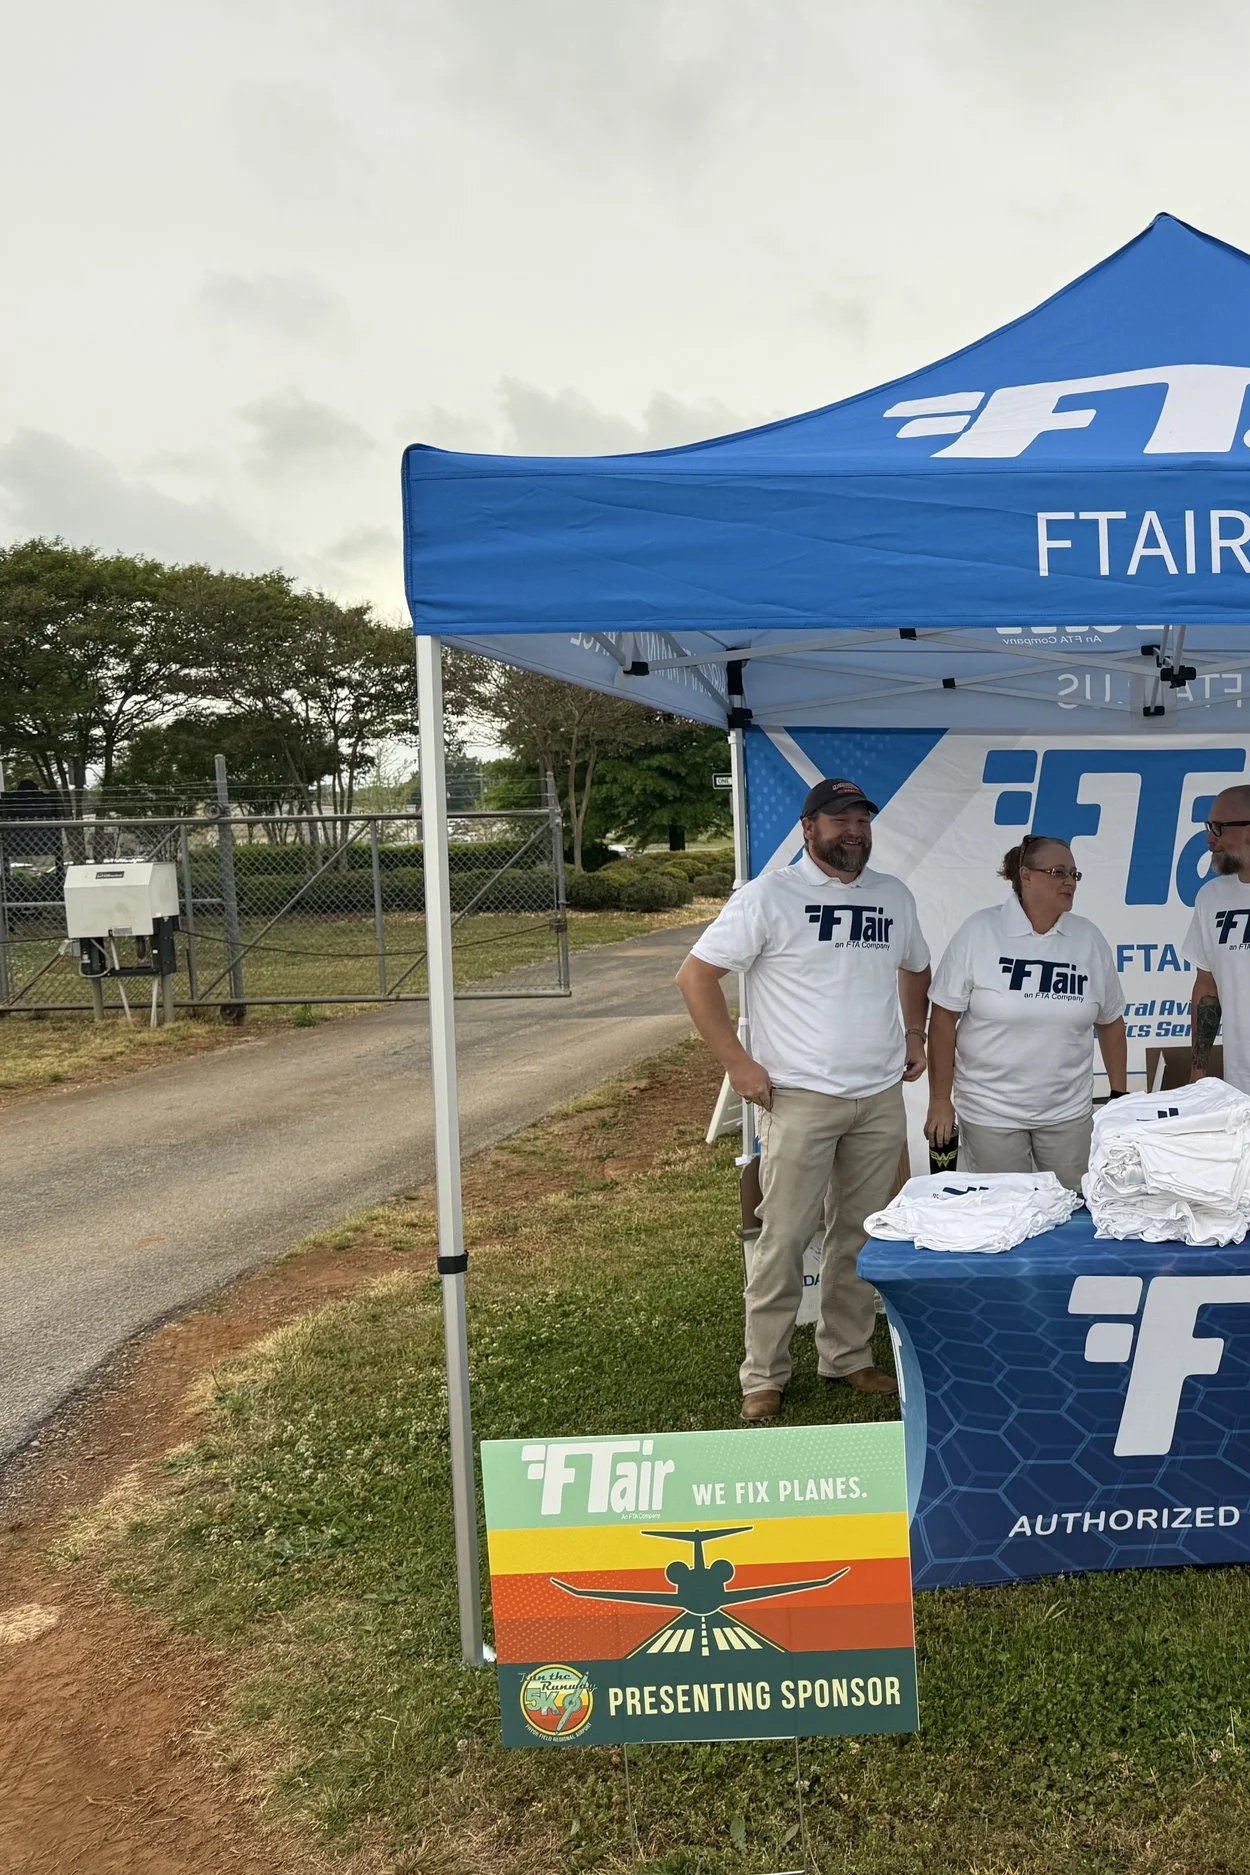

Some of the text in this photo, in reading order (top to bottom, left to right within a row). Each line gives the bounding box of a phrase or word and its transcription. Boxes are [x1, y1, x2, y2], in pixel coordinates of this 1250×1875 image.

[804, 904, 894, 943] FTair
[861, 941, 891, 951] Company
[998, 956, 1089, 995] FTair
[1051, 993, 1085, 1003] Company
[521, 1440, 676, 1516] FTair
[691, 1476, 868, 1507] WE FIX PLANES.
[1008, 1505, 1241, 1538] AUTHORIZED
[549, 1671, 573, 1680] the
[525, 1688, 561, 1716] 5K
[608, 1676, 901, 1717] PRESENTING SPONSOR
